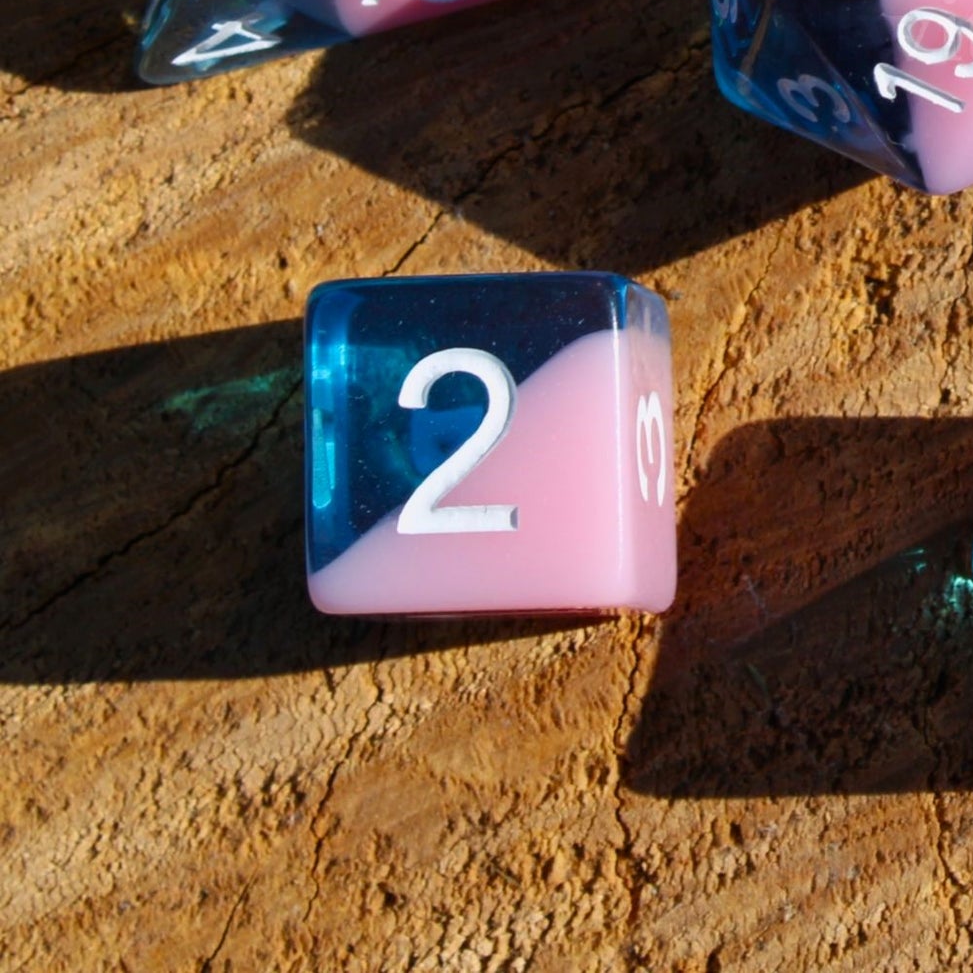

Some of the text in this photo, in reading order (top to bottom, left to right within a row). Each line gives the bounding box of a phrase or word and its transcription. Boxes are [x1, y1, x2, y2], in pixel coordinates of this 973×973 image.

[171, 14, 283, 65] 4
[777, 75, 850, 124] 3
[397, 347, 518, 534] 2
[636, 391, 666, 507] 3
